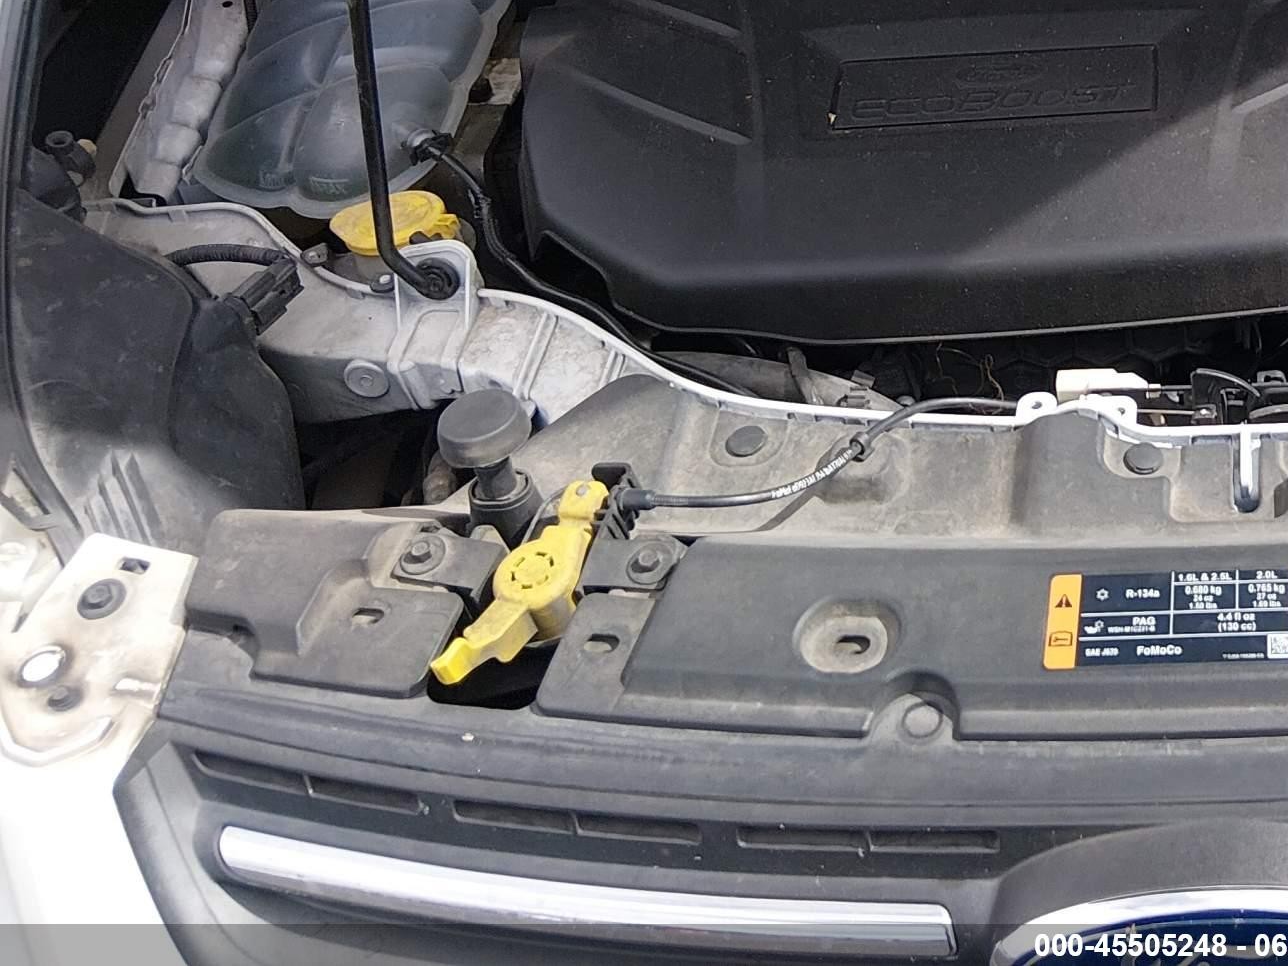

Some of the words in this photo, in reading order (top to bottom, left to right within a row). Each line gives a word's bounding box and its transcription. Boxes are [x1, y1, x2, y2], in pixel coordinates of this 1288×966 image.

[1256, 570, 1278, 579] 2.0L
[1125, 589, 1160, 599] R-134a
[1132, 616, 1156, 626] PAG
[1242, 614, 1256, 622] oz
[1217, 622, 1239, 633] (130
[1240, 622, 1257, 632] cc)
[1136, 644, 1183, 656] FoMoCo
